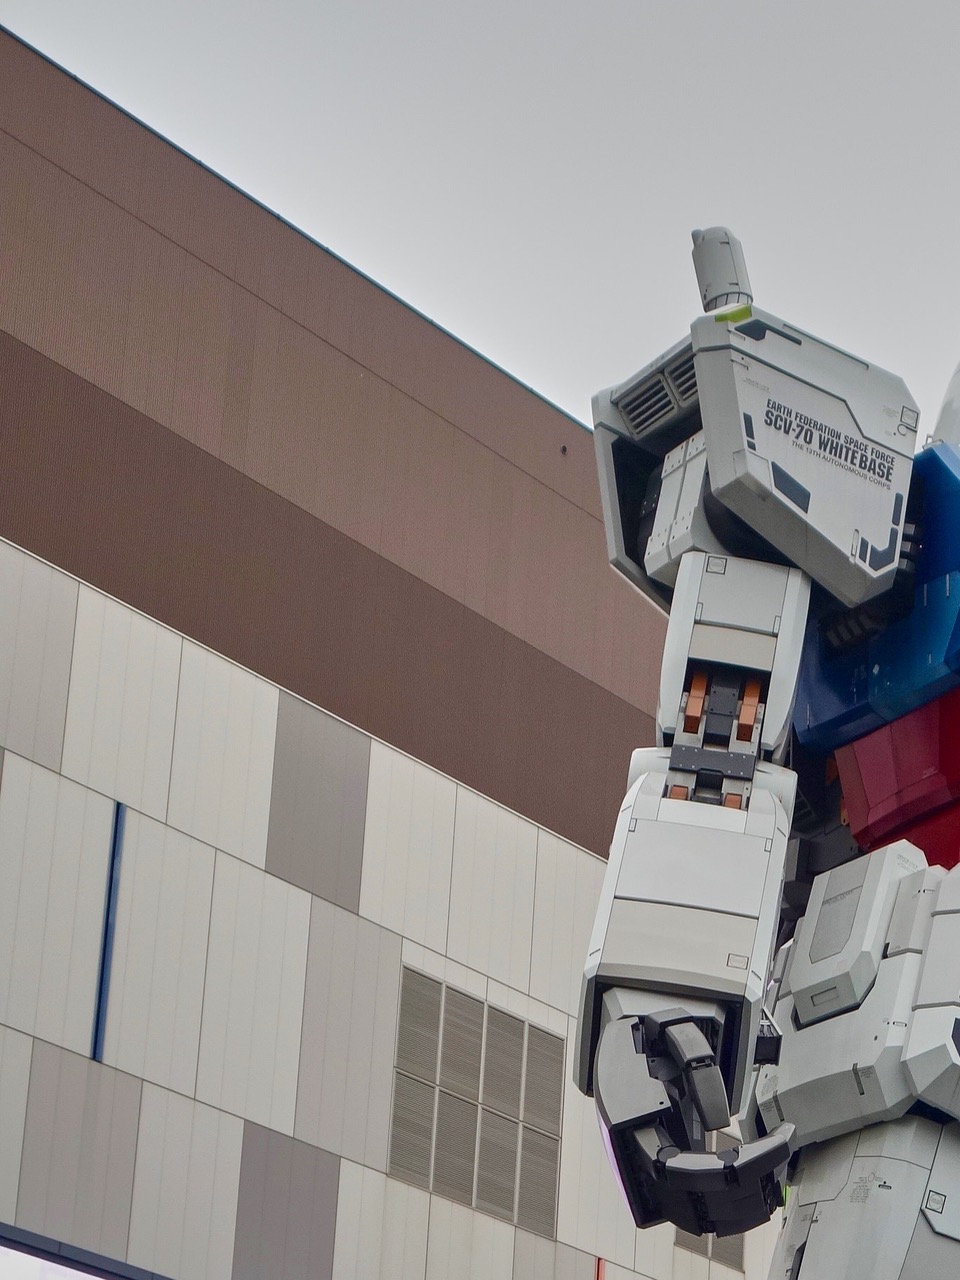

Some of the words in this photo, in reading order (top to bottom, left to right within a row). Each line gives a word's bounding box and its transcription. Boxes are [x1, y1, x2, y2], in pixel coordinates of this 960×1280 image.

[764, 409, 813, 445] SCV-70
[766, 398, 792, 418] EARTH
[794, 411, 841, 441] FEDERATION
[843, 435, 869, 454] SPACE
[870, 447, 895, 467] FORCE
[792, 440, 805, 452] THE
[805, 447, 821, 459] 13TH
[821, 454, 867, 480] AUTONOMOUS
[868, 475, 891, 490] CORPS
